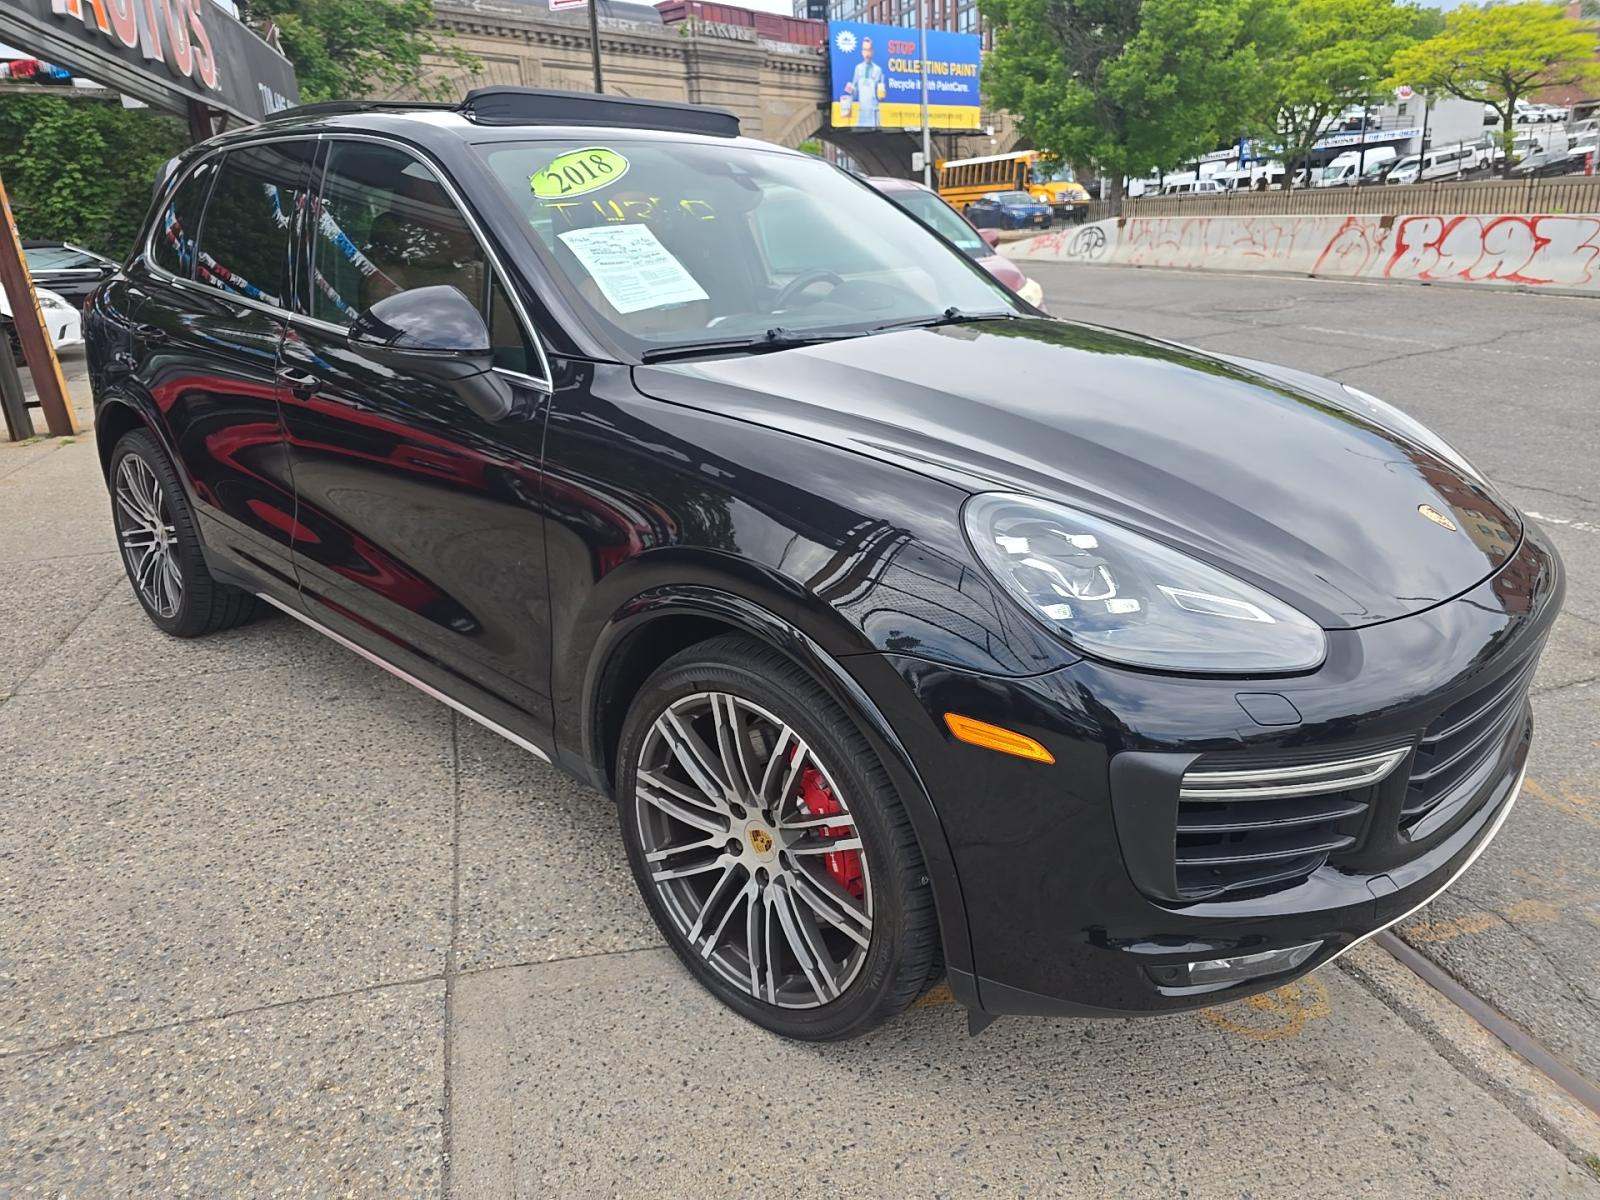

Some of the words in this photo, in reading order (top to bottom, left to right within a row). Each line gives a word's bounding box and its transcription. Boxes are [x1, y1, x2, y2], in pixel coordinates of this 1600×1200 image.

[888, 40, 915, 54] STOP
[888, 58, 948, 75] COLLETING
[950, 63, 977, 77] PAINT
[888, 78, 915, 91] Recycle
[546, 154, 613, 194] 2018
[543, 197, 716, 226] TUO
